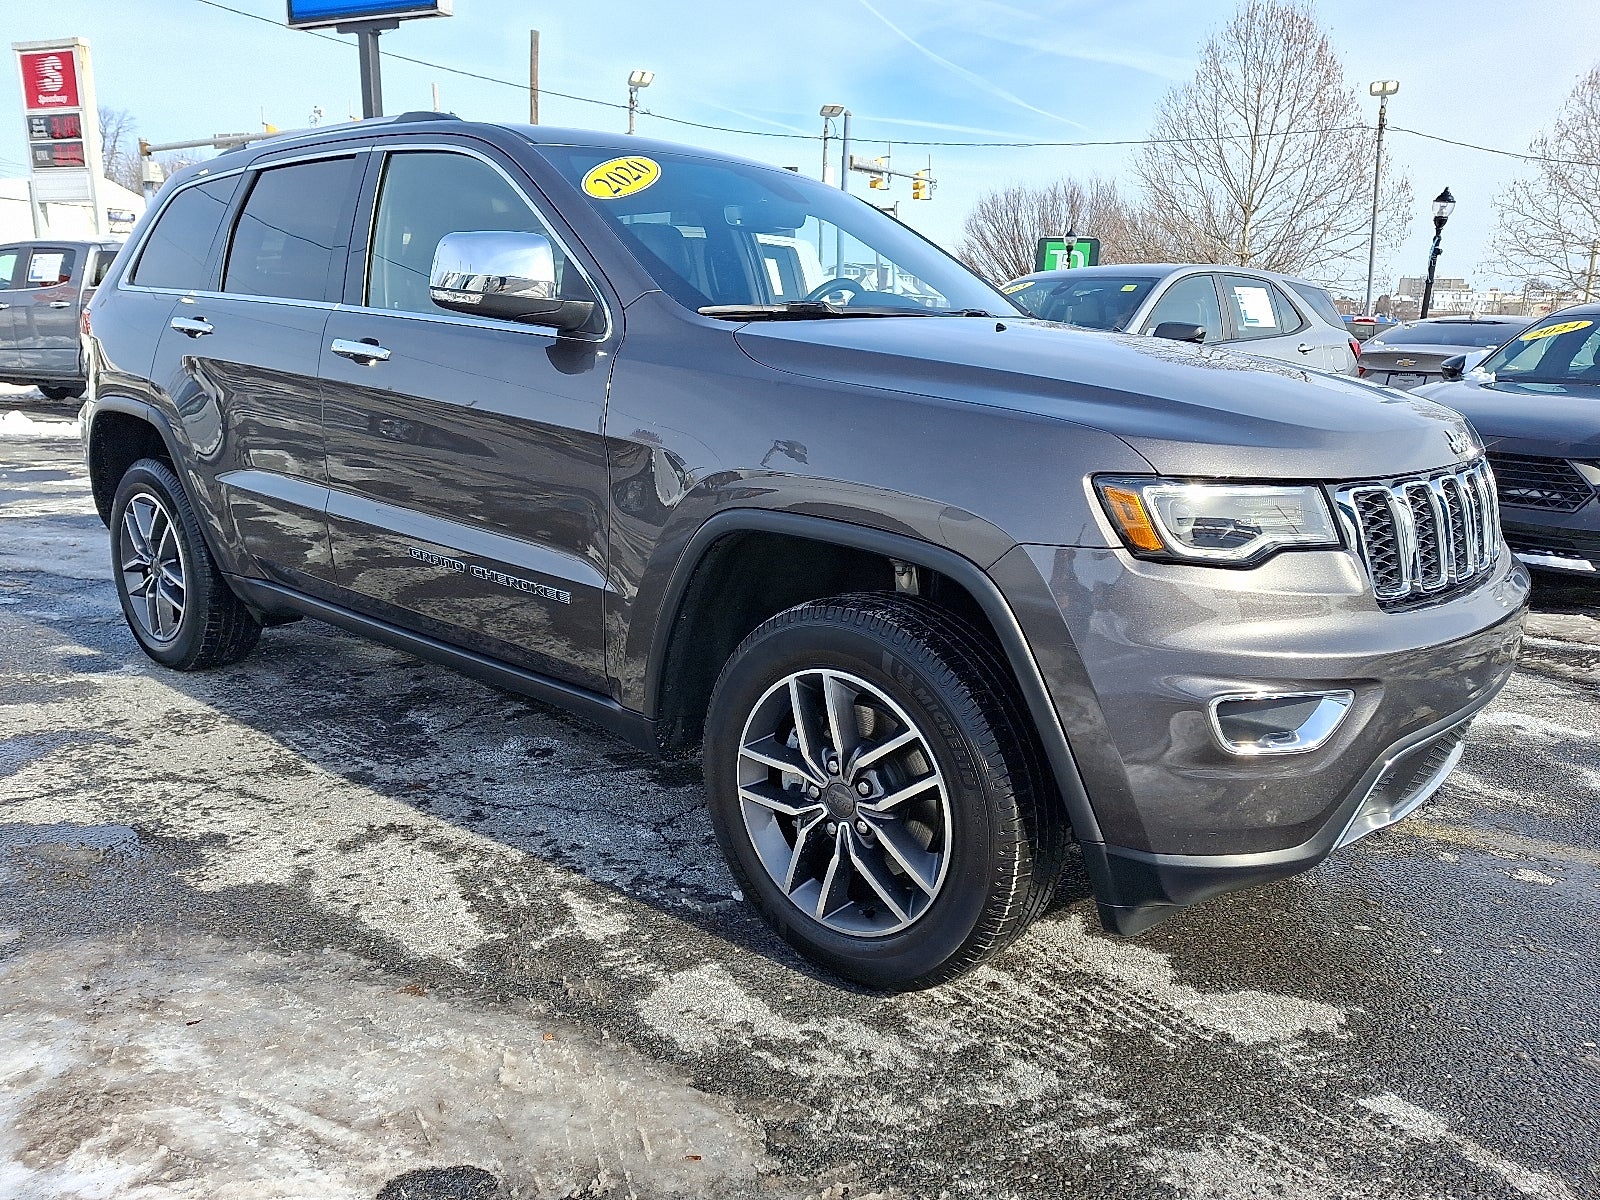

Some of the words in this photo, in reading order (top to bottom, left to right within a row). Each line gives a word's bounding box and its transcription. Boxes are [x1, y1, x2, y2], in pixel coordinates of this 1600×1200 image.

[593, 160, 651, 194] 2020
[409, 547, 466, 573] GRAND
[470, 564, 572, 604] CHEROKEE
[913, 687, 977, 788] MICHELIN
